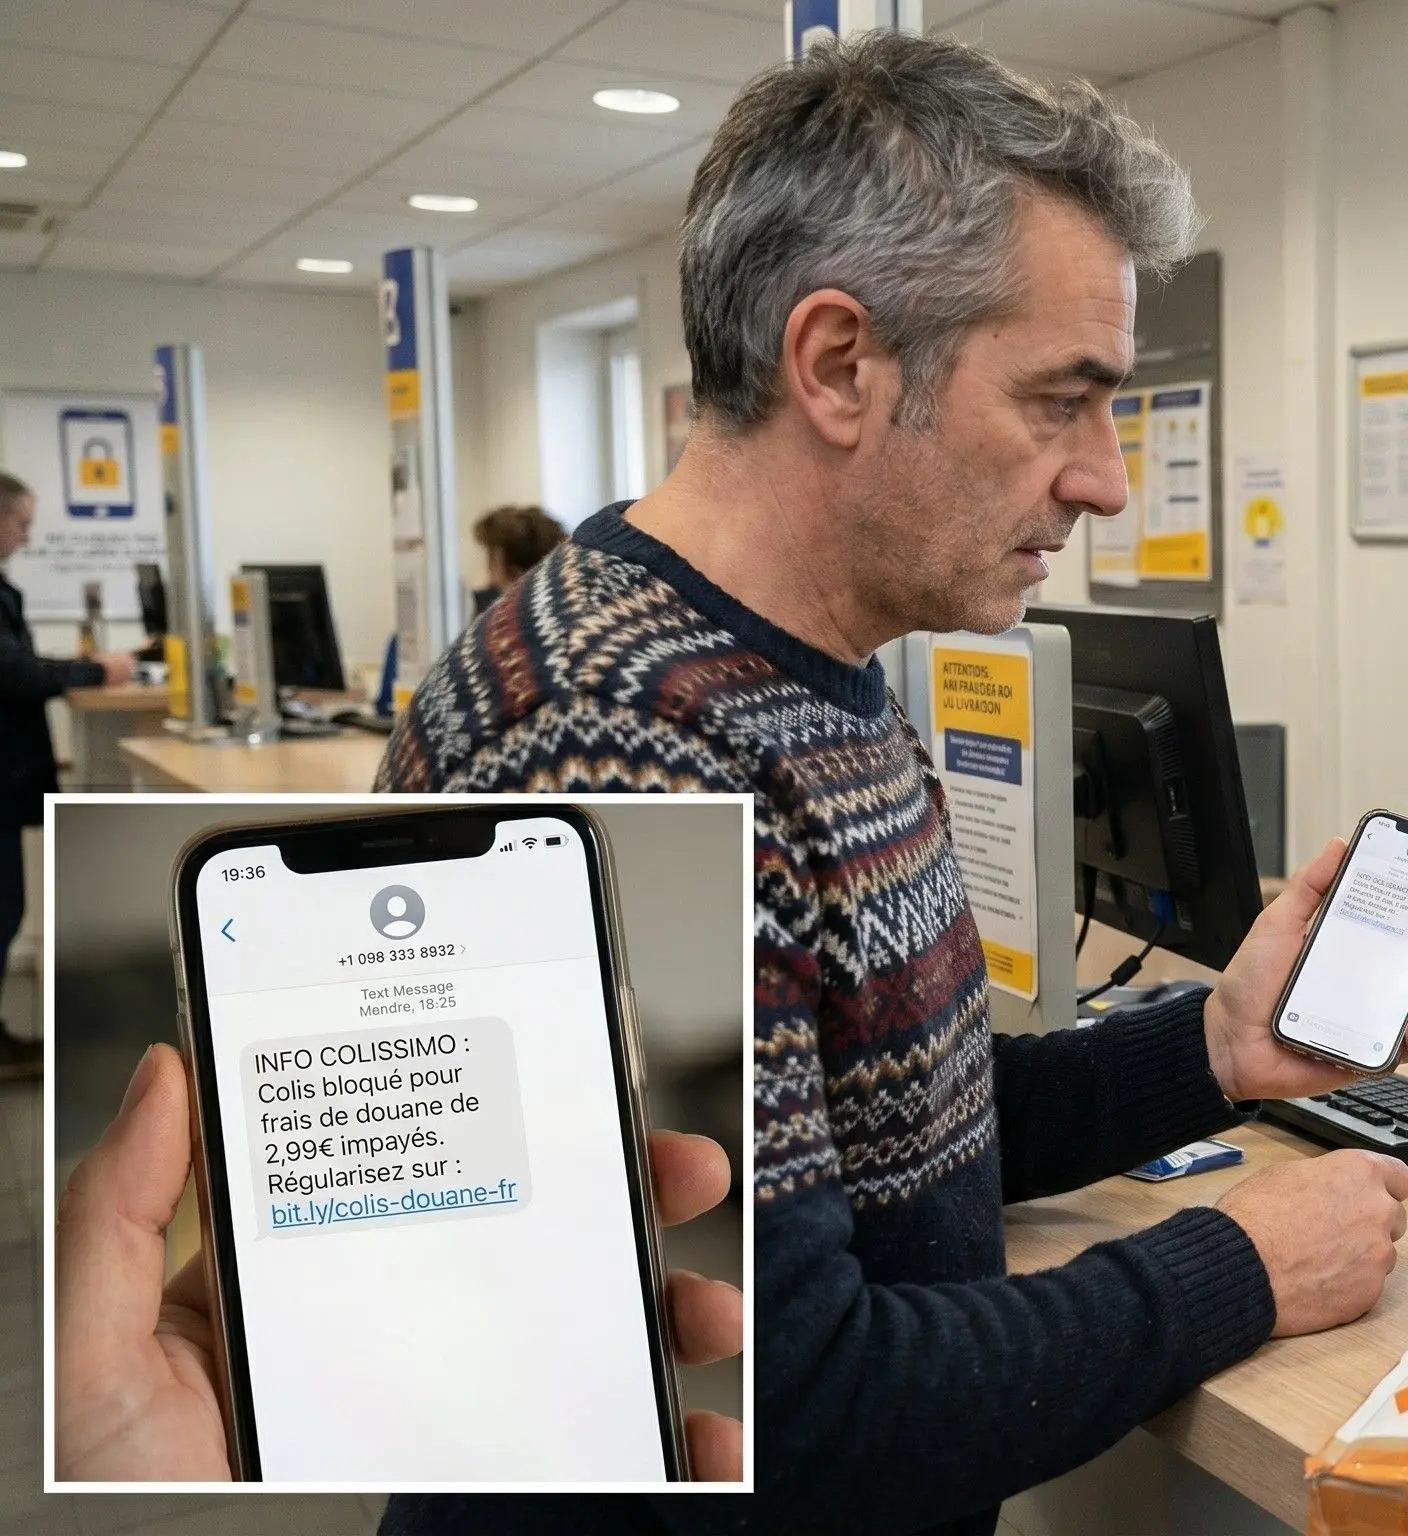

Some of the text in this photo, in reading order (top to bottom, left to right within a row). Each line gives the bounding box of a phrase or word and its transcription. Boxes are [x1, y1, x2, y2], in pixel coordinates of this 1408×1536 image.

[222, 865, 266, 882] 19:36
[339, 944, 455, 966] +1 098 333 8932
[360, 996, 457, 1017] Mendre, 18:25
[361, 981, 454, 1000] Text Message
[255, 1049, 313, 1074] INFO
[320, 1034, 456, 1067] COLISSIMO
[258, 1067, 463, 1104] Colis bloqué pour
[261, 1092, 480, 1133] frais de douane de
[265, 1127, 444, 1166] 2,99€ impayés.
[268, 1163, 404, 1196] Régularisez
[412, 1159, 448, 1178] sur
[271, 1178, 518, 1228] bit.ly/colis-douane-fr
